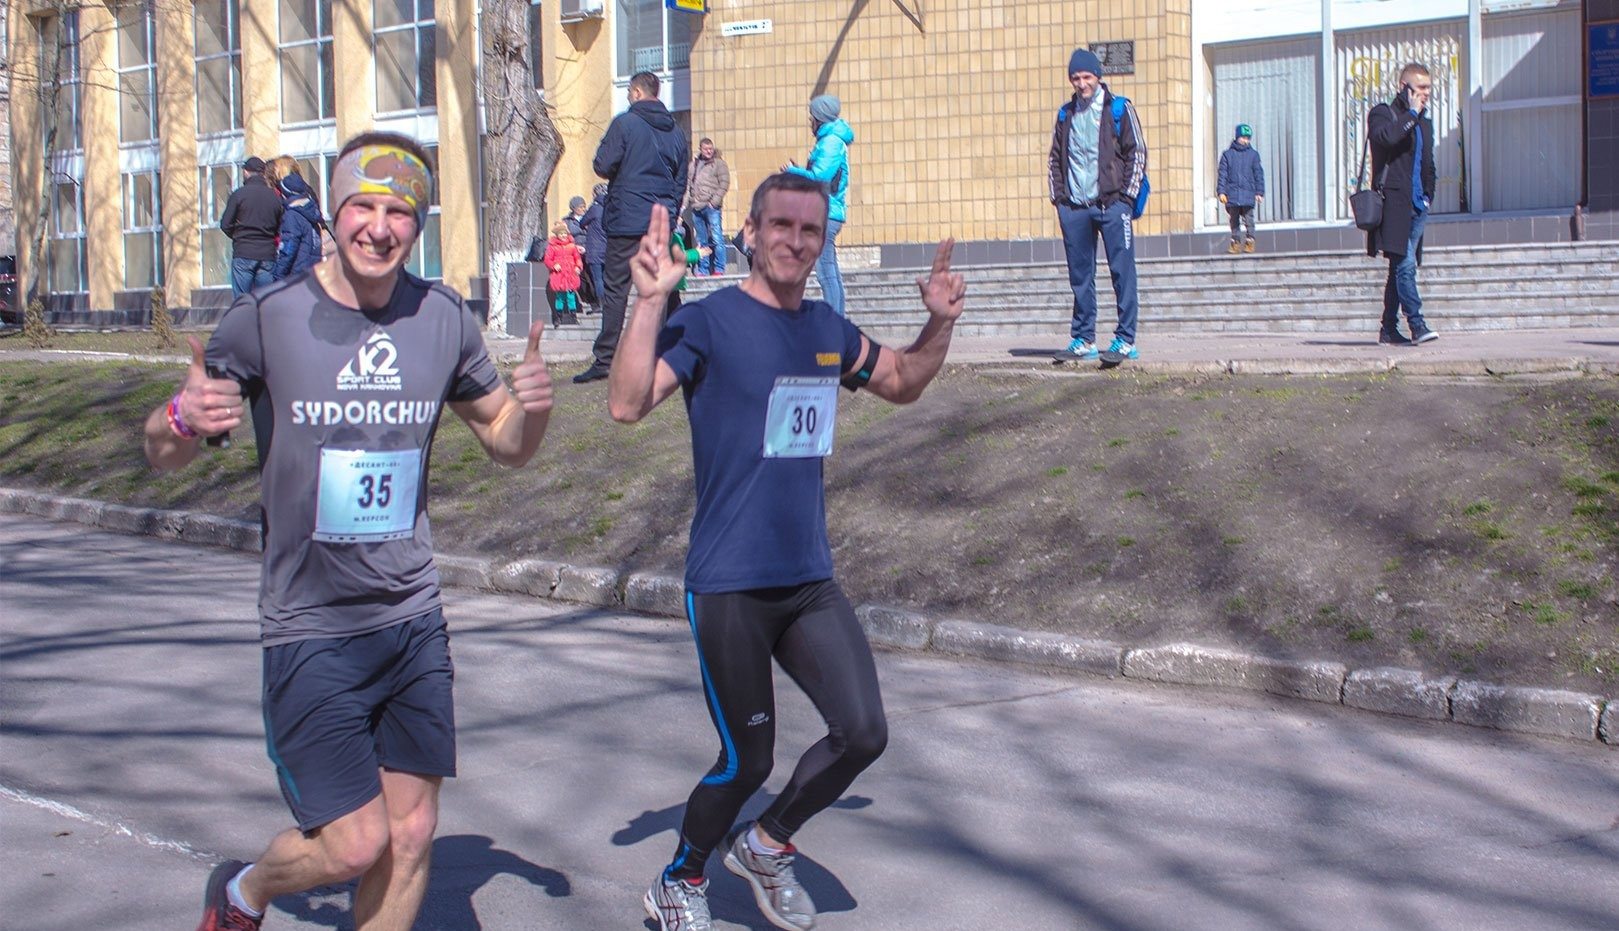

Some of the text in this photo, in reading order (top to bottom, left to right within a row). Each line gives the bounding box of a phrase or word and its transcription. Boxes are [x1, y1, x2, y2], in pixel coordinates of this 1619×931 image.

[336, 376, 402, 384] SPORT CLUB
[792, 405, 817, 435] 30
[357, 474, 392, 510] 35
